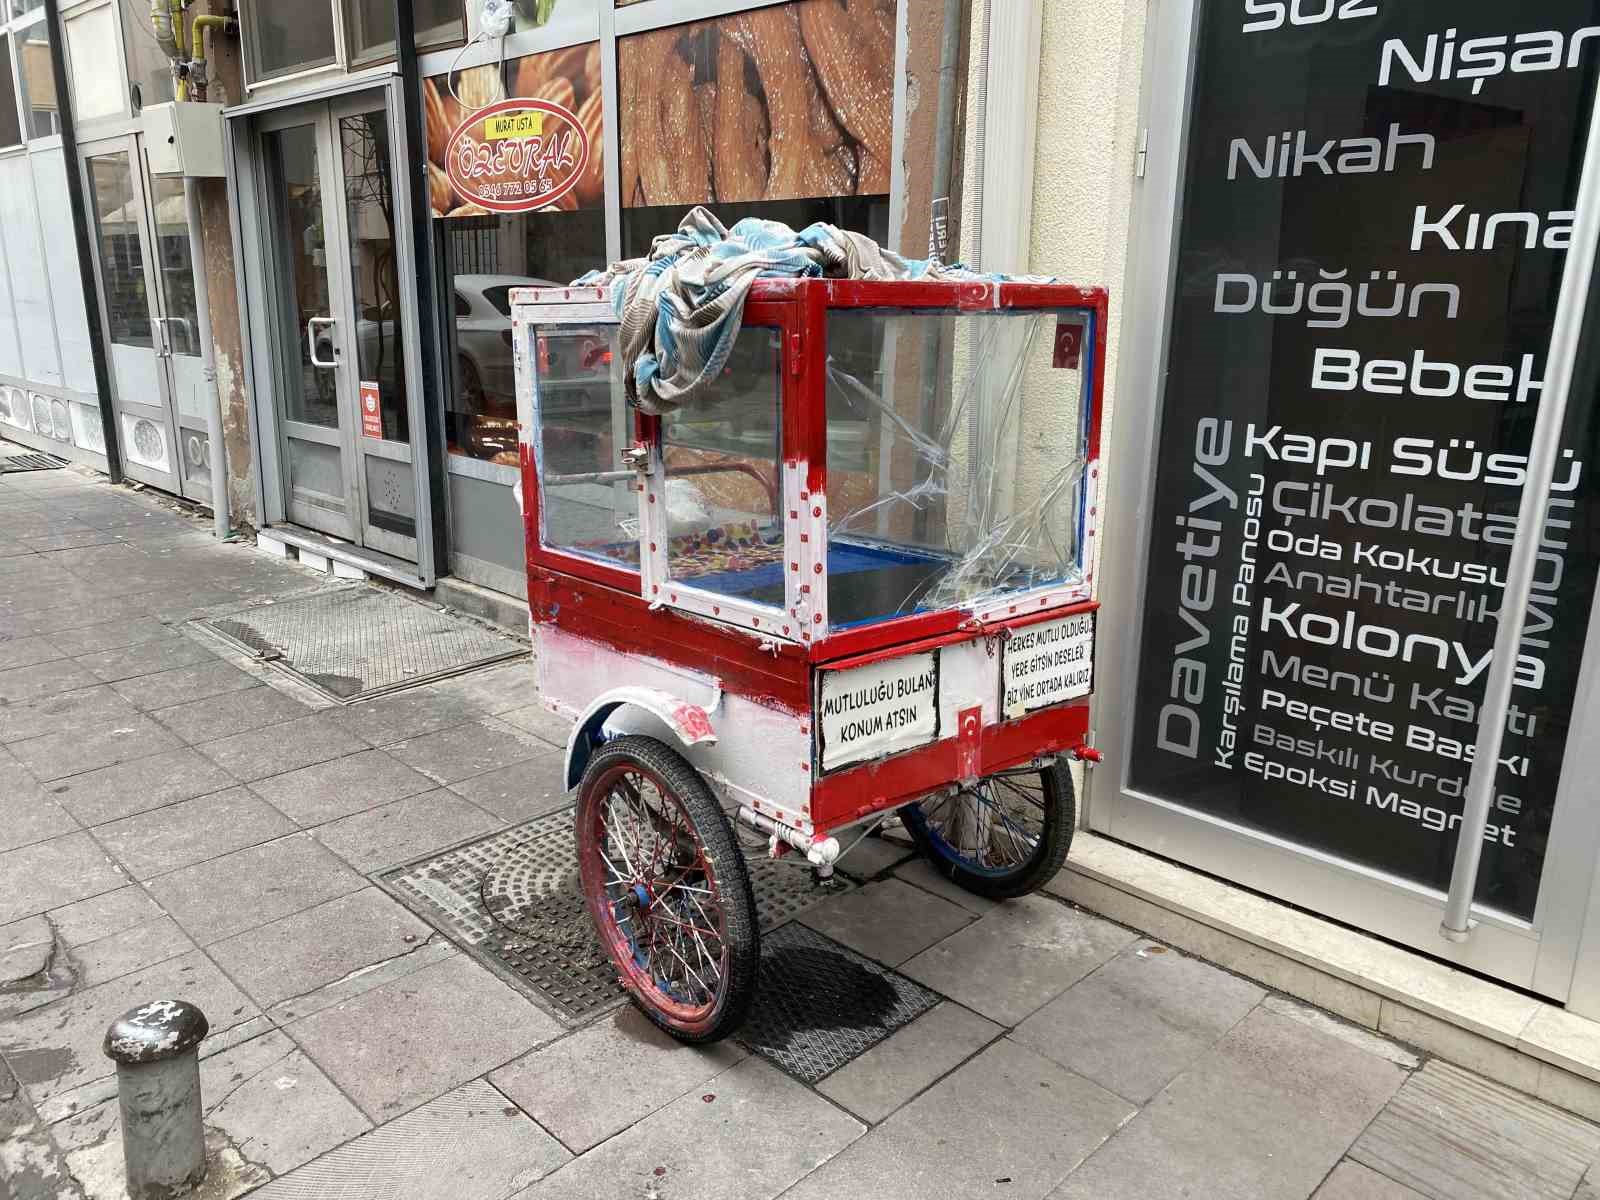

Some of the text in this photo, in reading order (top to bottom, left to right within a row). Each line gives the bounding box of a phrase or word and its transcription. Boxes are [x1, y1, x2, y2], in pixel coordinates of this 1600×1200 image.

[495, 114, 533, 133] MURAT USTA
[1227, 123, 1435, 180] Nikah
[1214, 268, 1460, 328] Düğün
[1244, 423, 1372, 476] Kapı
[1272, 480, 1520, 547] Çikolata
[1267, 529, 1343, 561] Oda
[1157, 417, 1239, 759] Davetiye
[1263, 561, 1503, 624] Anahtarlık
[1007, 631, 1035, 654] HERKES
[1036, 625, 1060, 648] MUTLU
[1214, 473, 1265, 769] Karşılama Panosu
[1007, 668, 1090, 707] BİZ YİNE ORTADA KALIRIZ
[1011, 645, 1084, 680] YERE GİTSİN DESELER
[823, 680, 894, 718] MUTLULUĞU
[1261, 650, 1537, 738] Menü Katı
[1261, 689, 1394, 742] Peçete
[840, 706, 917, 743] KONUM ATSIN
[1253, 724, 1359, 770] Baskılı
[1244, 752, 1357, 800] Epoksi
